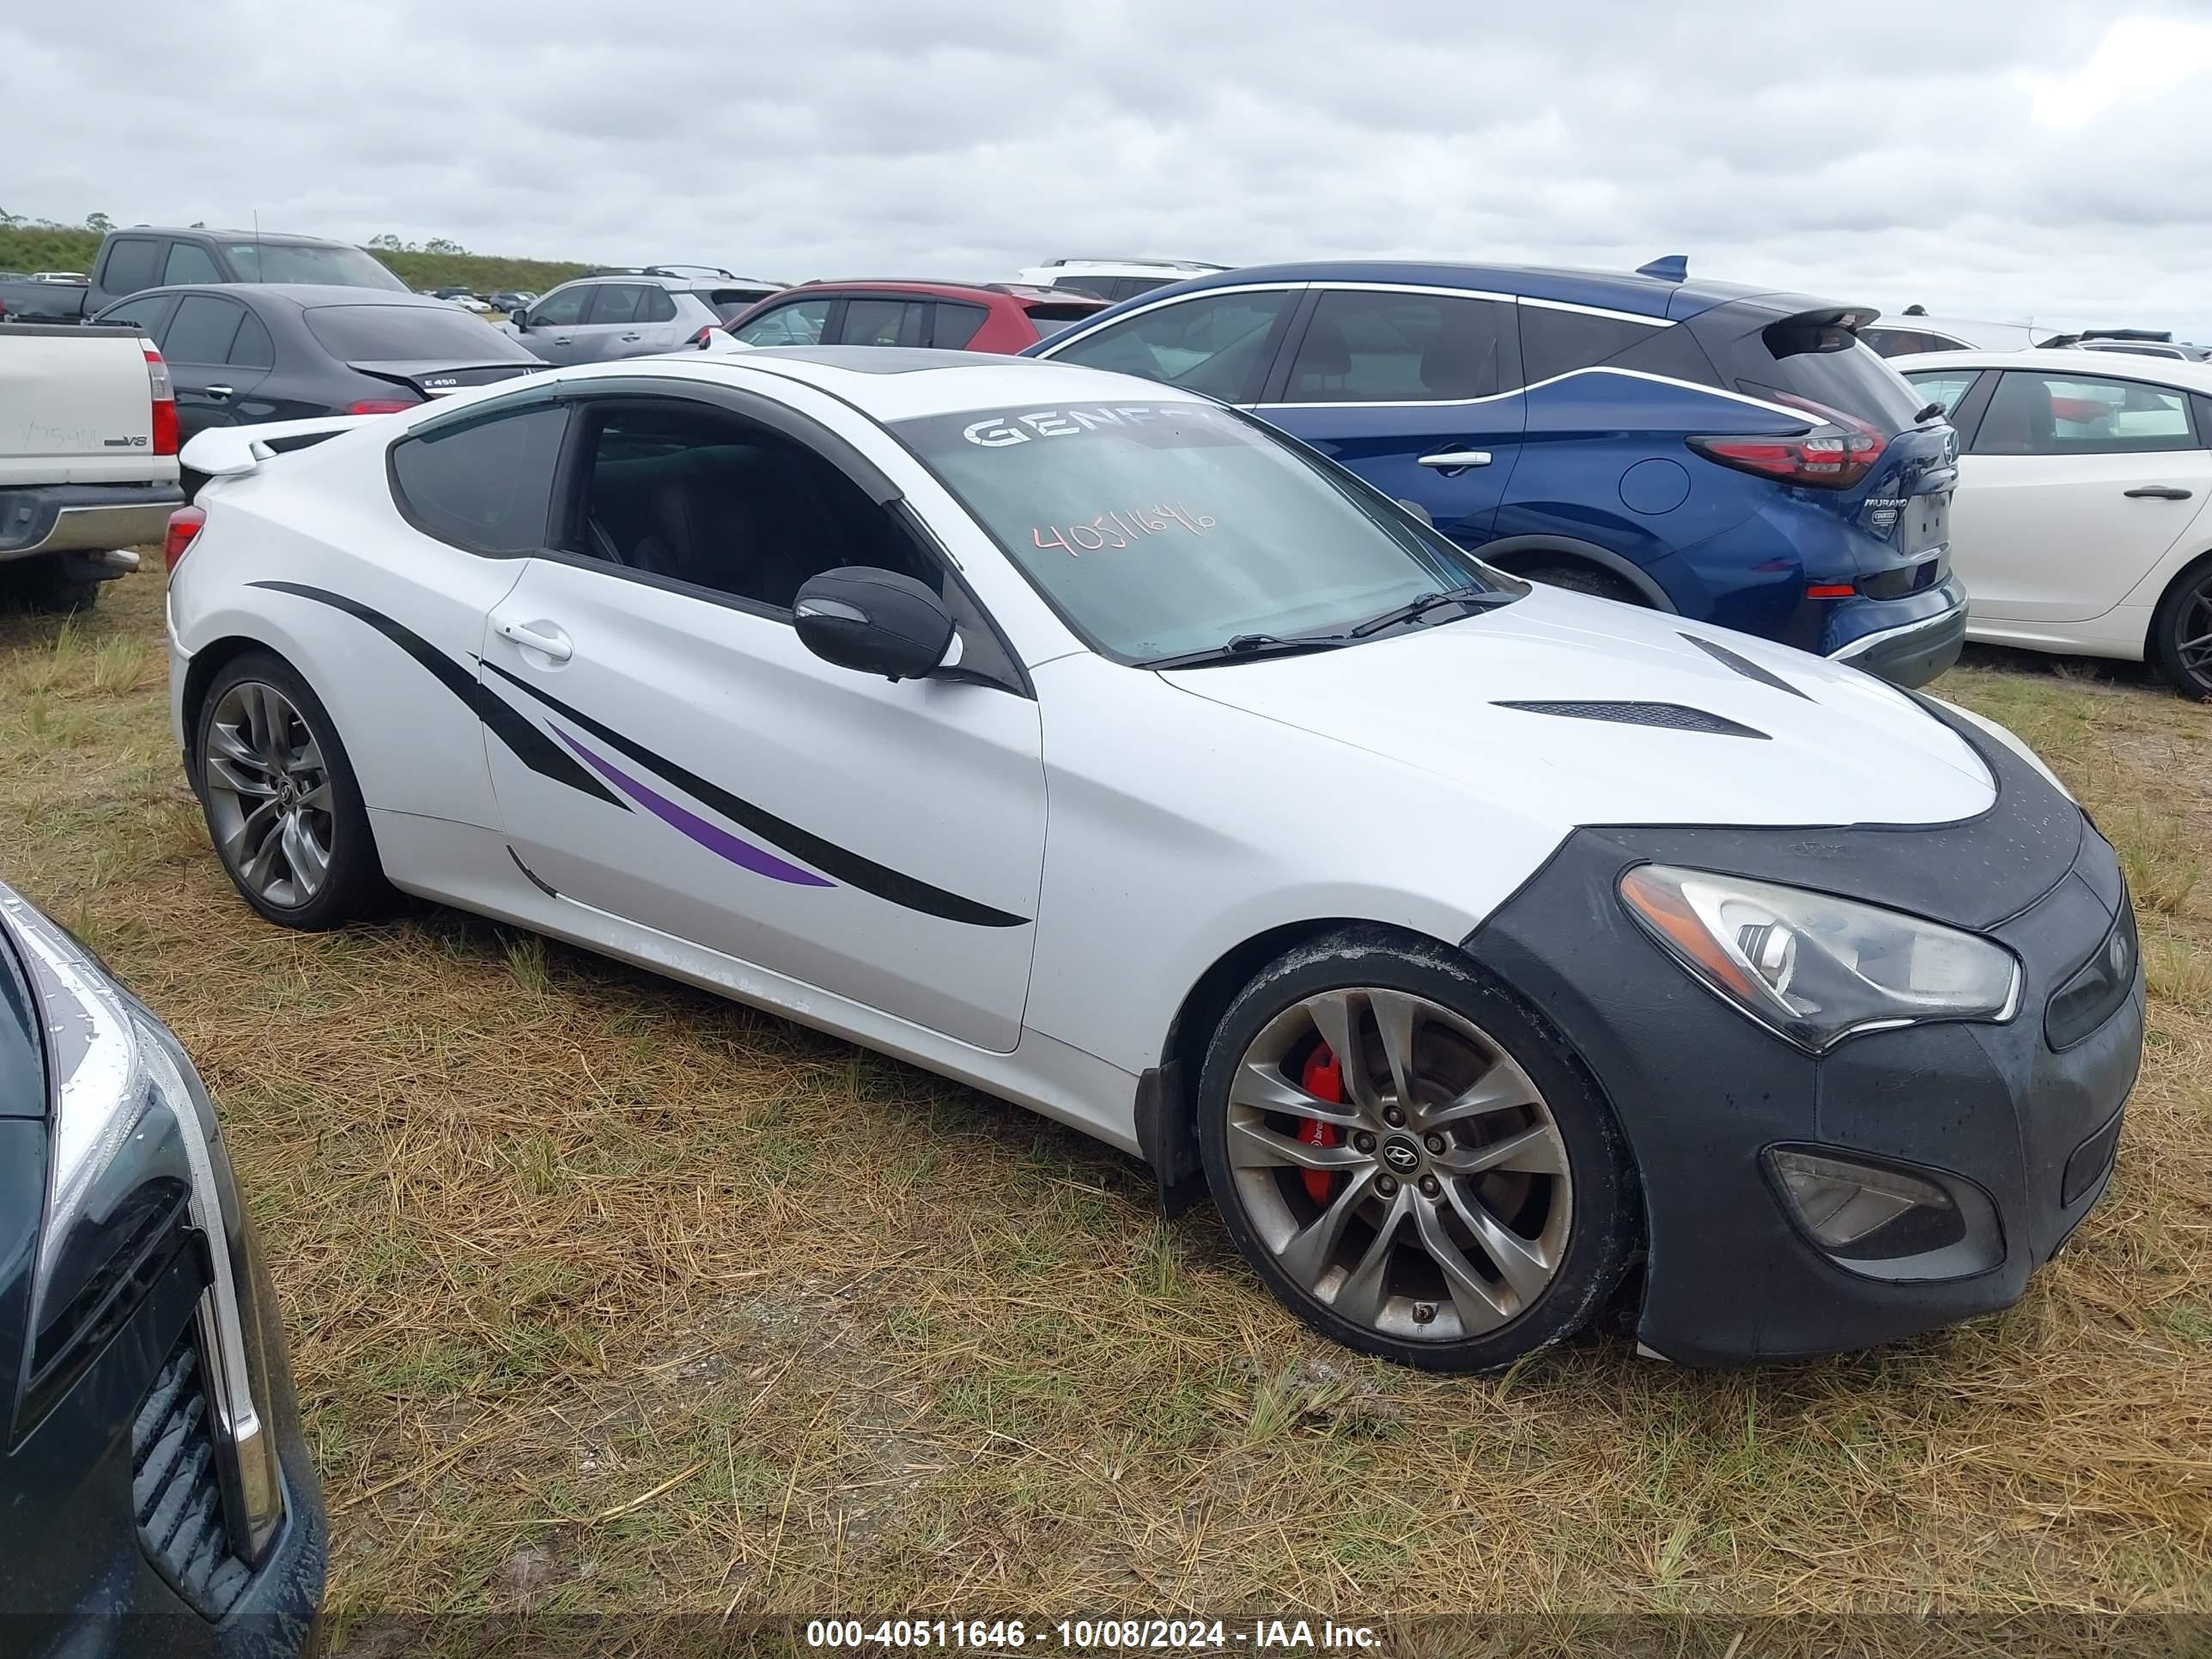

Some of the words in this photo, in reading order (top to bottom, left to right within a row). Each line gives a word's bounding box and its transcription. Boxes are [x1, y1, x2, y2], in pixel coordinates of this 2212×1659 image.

[123, 435, 147, 447] V8
[1863, 498, 1908, 507] MURANO
[1032, 501, 1216, 557] 40511646
